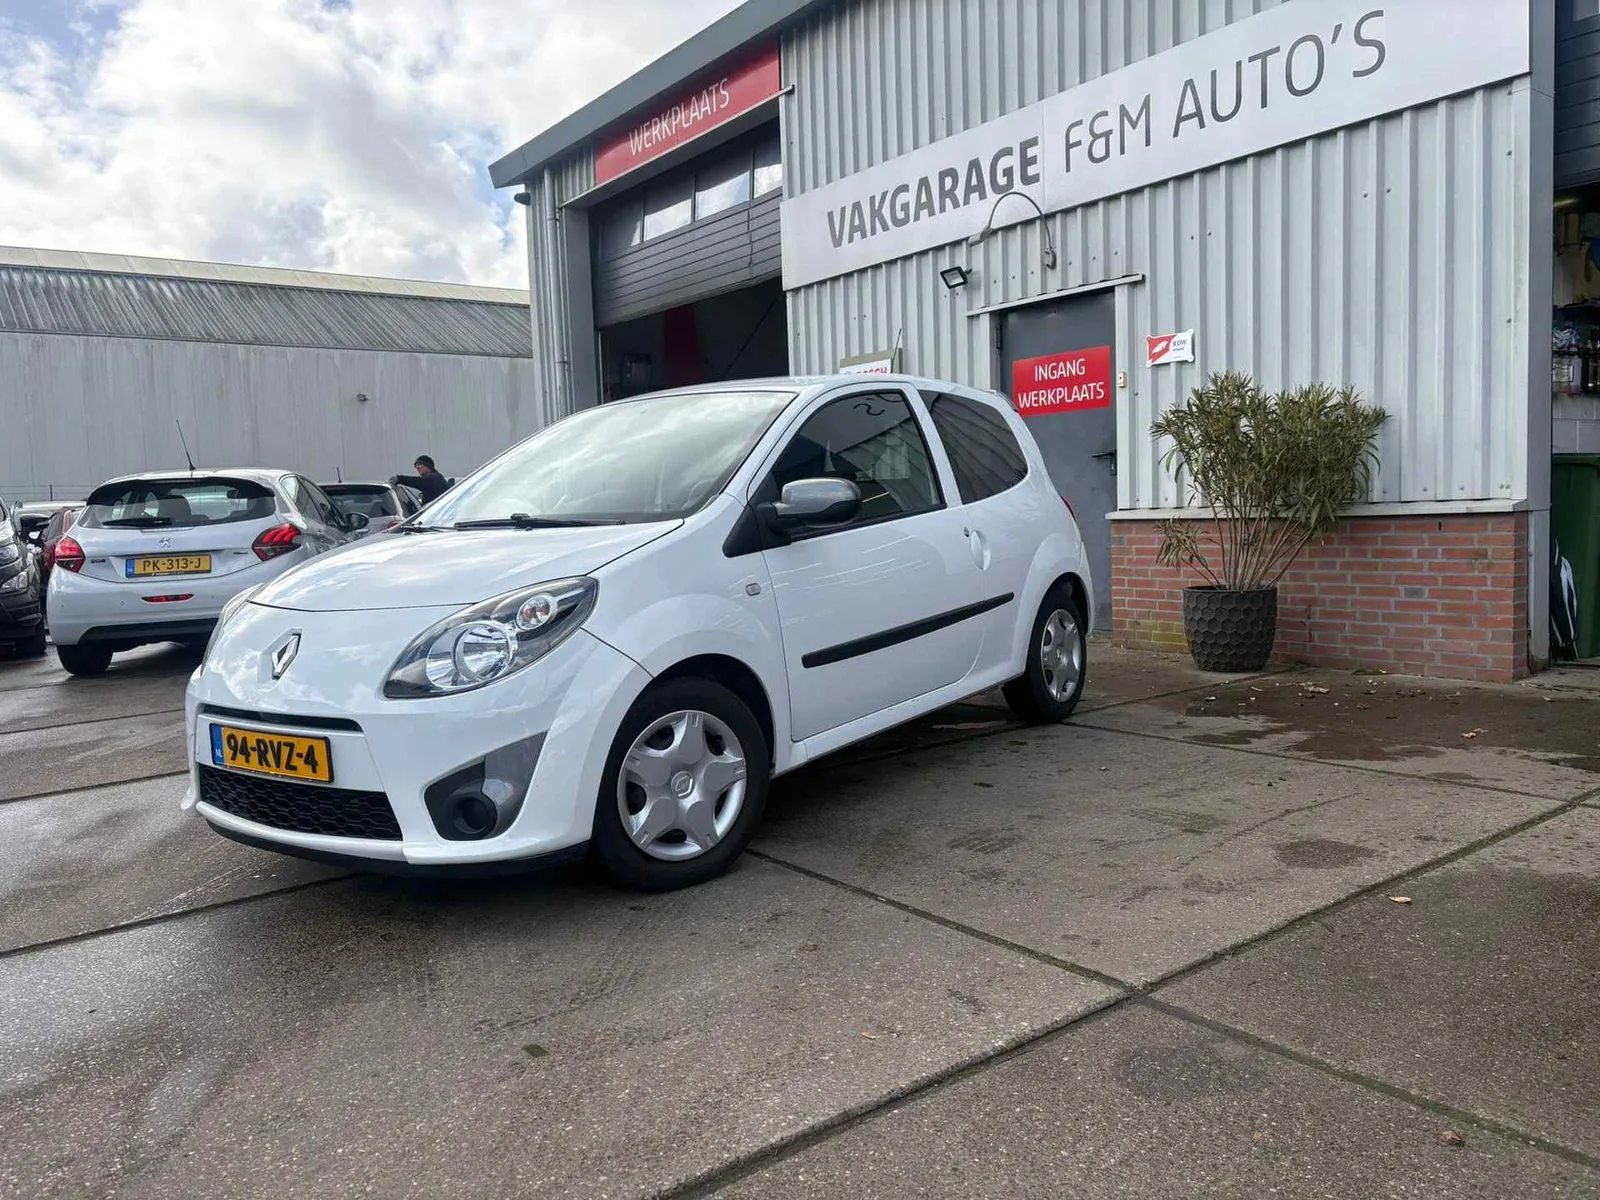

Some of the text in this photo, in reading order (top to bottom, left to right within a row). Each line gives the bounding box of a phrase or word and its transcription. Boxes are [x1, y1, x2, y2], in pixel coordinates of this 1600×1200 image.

[628, 77, 730, 156] WERKPLAATS
[826, 10, 1387, 248] VAKGARAGE F&M AUTO'S
[1034, 358, 1086, 382] INGANG
[1018, 382, 1105, 409] WERKPLAATS
[143, 557, 201, 572] PK-313-J
[226, 733, 318, 774] 94-RVZ-4
